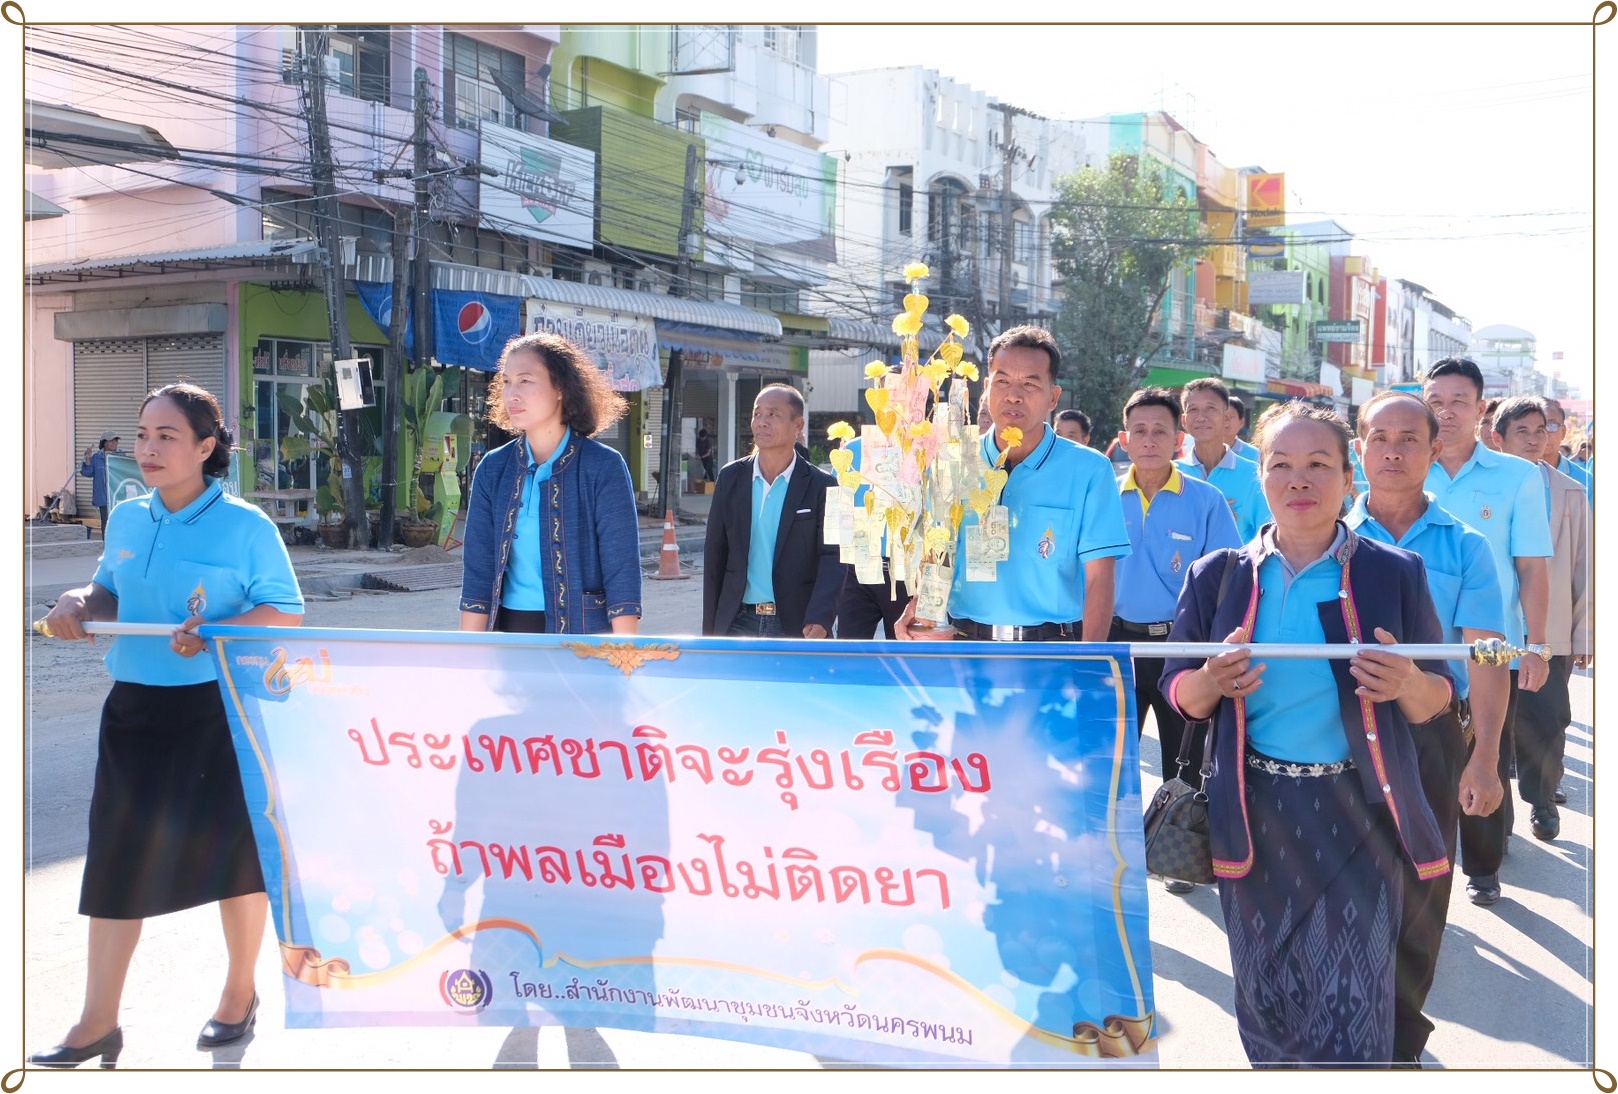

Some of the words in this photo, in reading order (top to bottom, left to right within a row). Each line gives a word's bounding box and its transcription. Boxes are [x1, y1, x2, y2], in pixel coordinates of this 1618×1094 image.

[1250, 208, 1281, 217] Kodak
[347, 717, 992, 811] ประเทศชาติจะรุ่งเรือง
[426, 819, 952, 911] ถ้าพลเมืองไม่ติดยา
